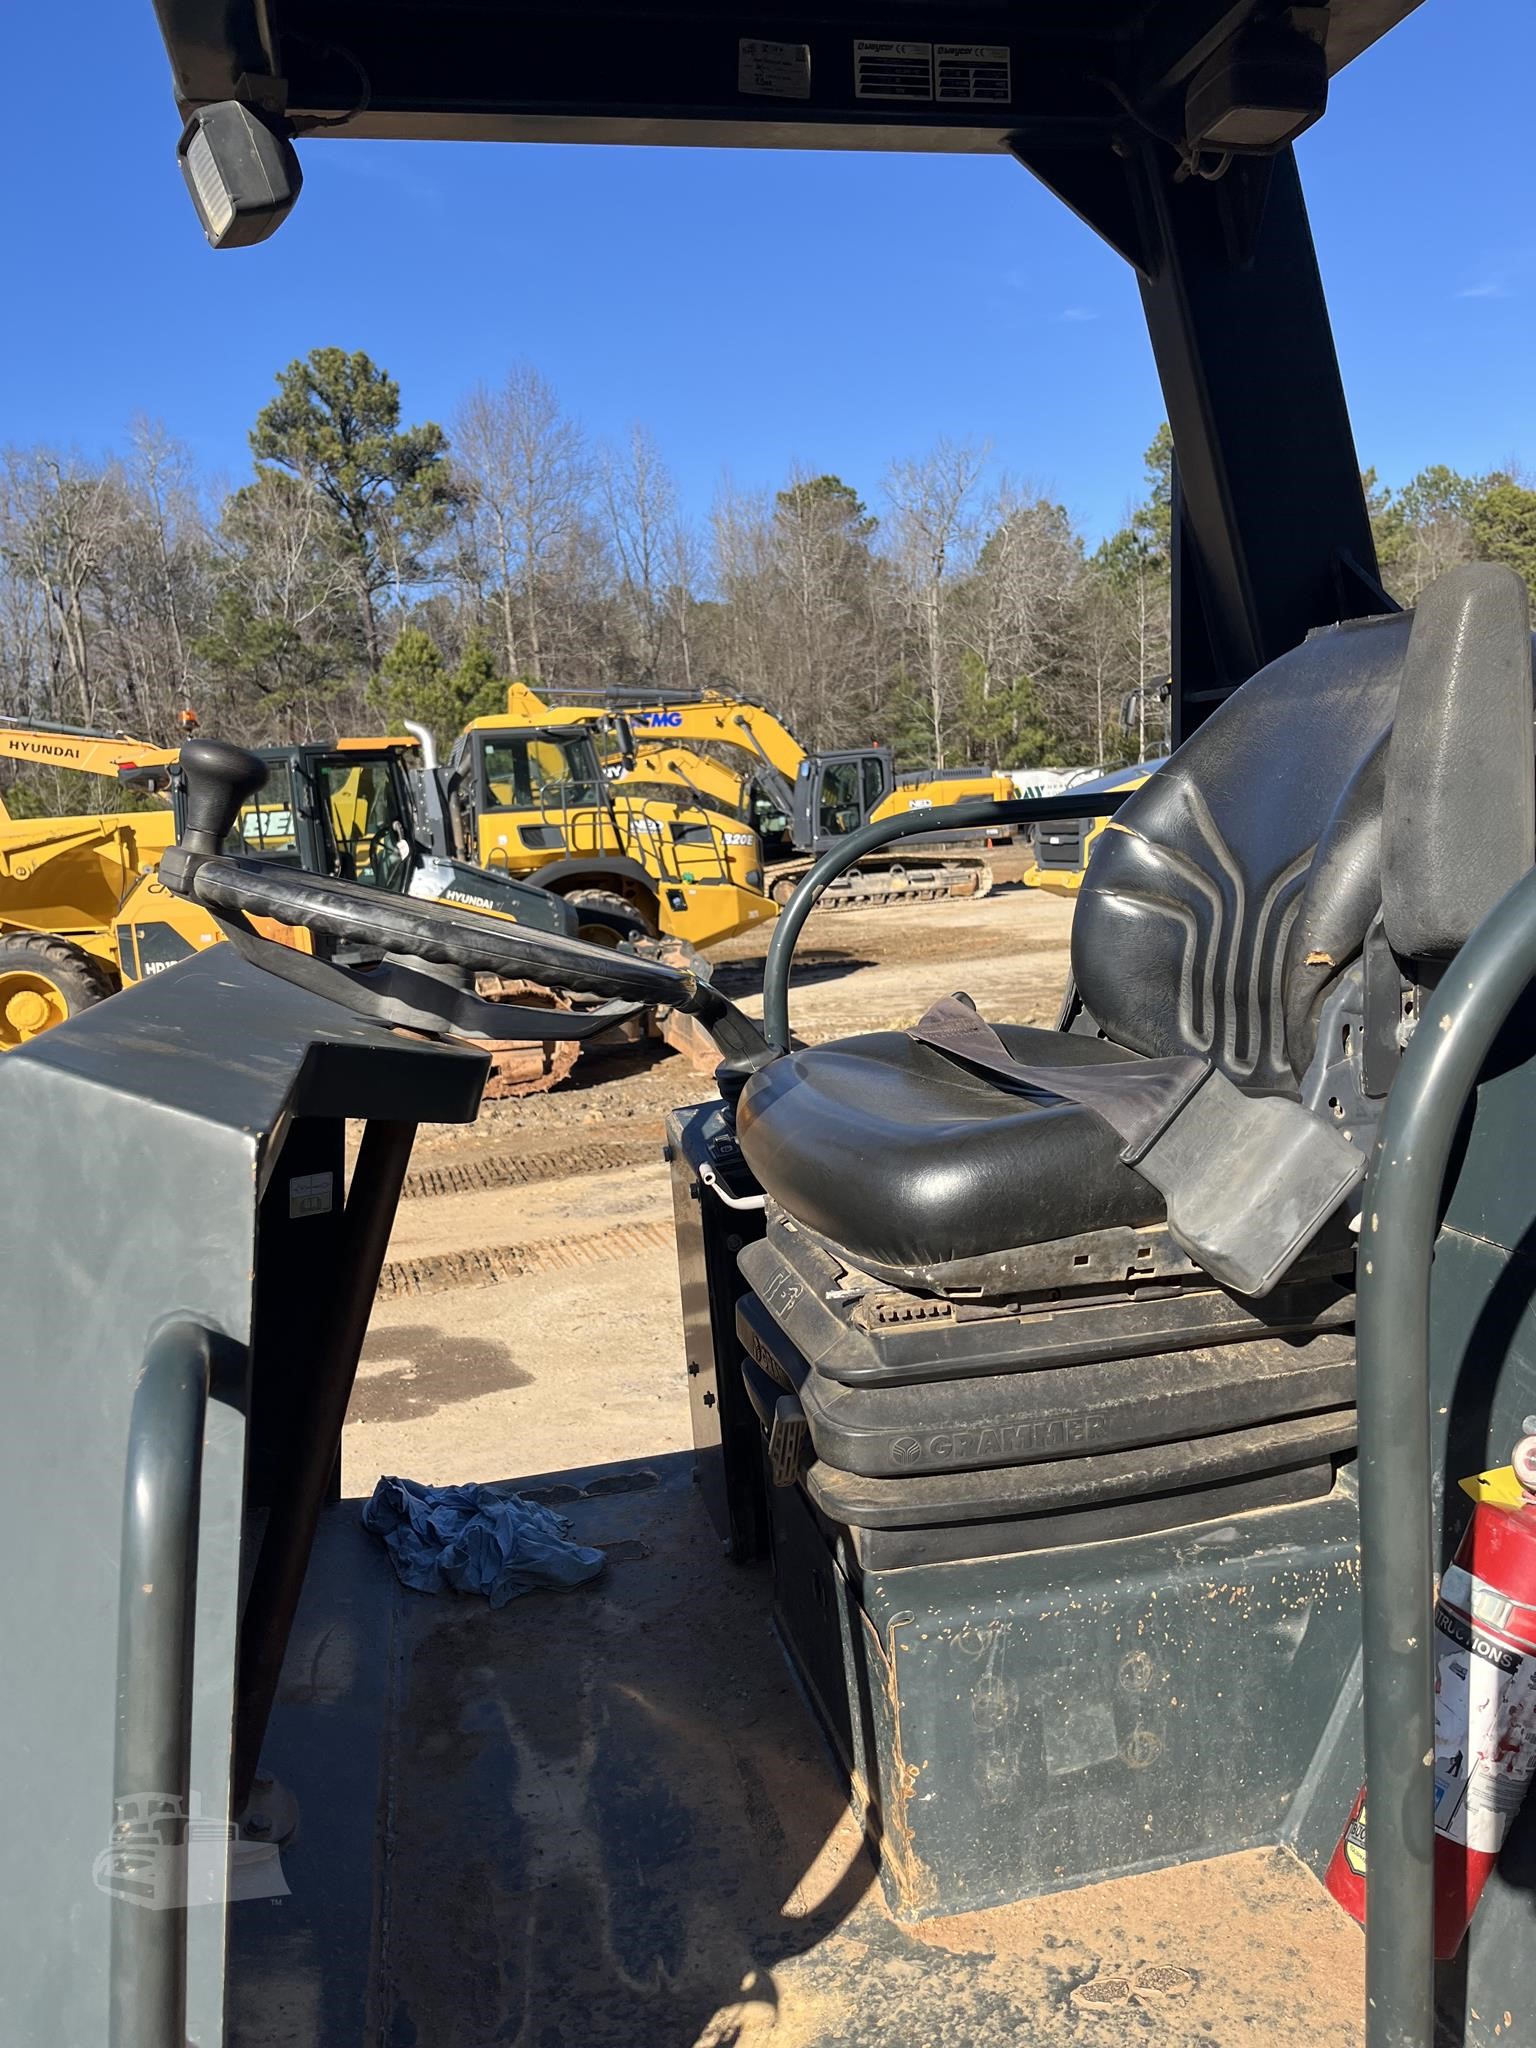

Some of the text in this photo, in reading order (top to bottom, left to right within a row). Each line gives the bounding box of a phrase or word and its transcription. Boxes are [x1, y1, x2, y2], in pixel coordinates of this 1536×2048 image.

[9, 740, 80, 759] HYUNDAI
[446, 889, 494, 910] HYUNDAI
[929, 1414, 1107, 1458] GRAMMER
